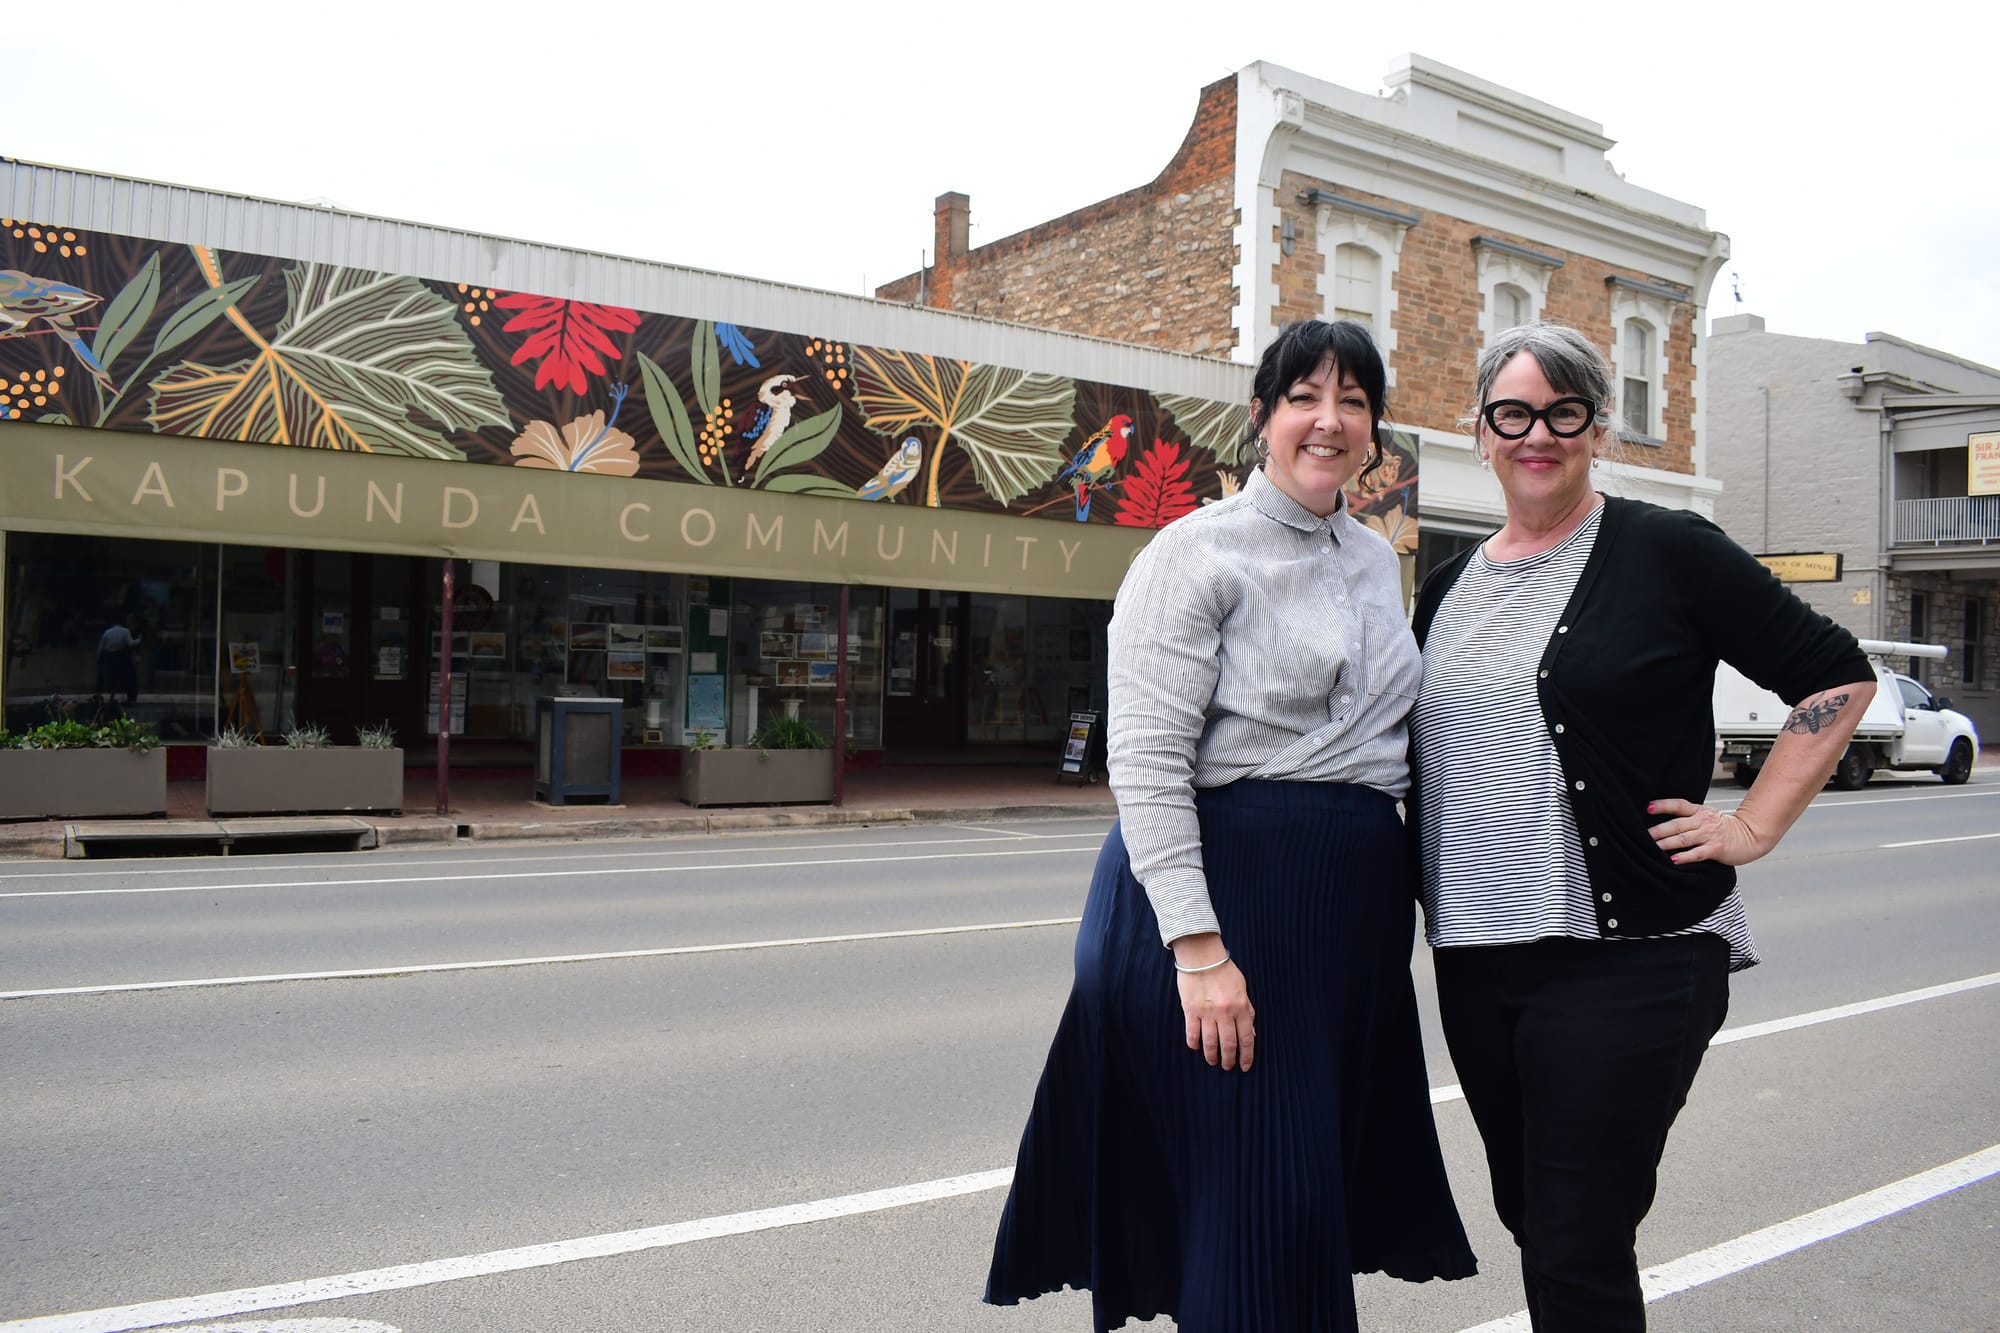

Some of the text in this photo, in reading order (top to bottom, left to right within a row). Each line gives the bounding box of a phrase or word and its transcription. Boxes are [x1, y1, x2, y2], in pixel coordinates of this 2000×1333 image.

[1975, 442, 1992, 451] SIR
[54, 453, 1081, 573] KAPUNDA COMMUNITY
[1805, 562, 1833, 572] MINES
